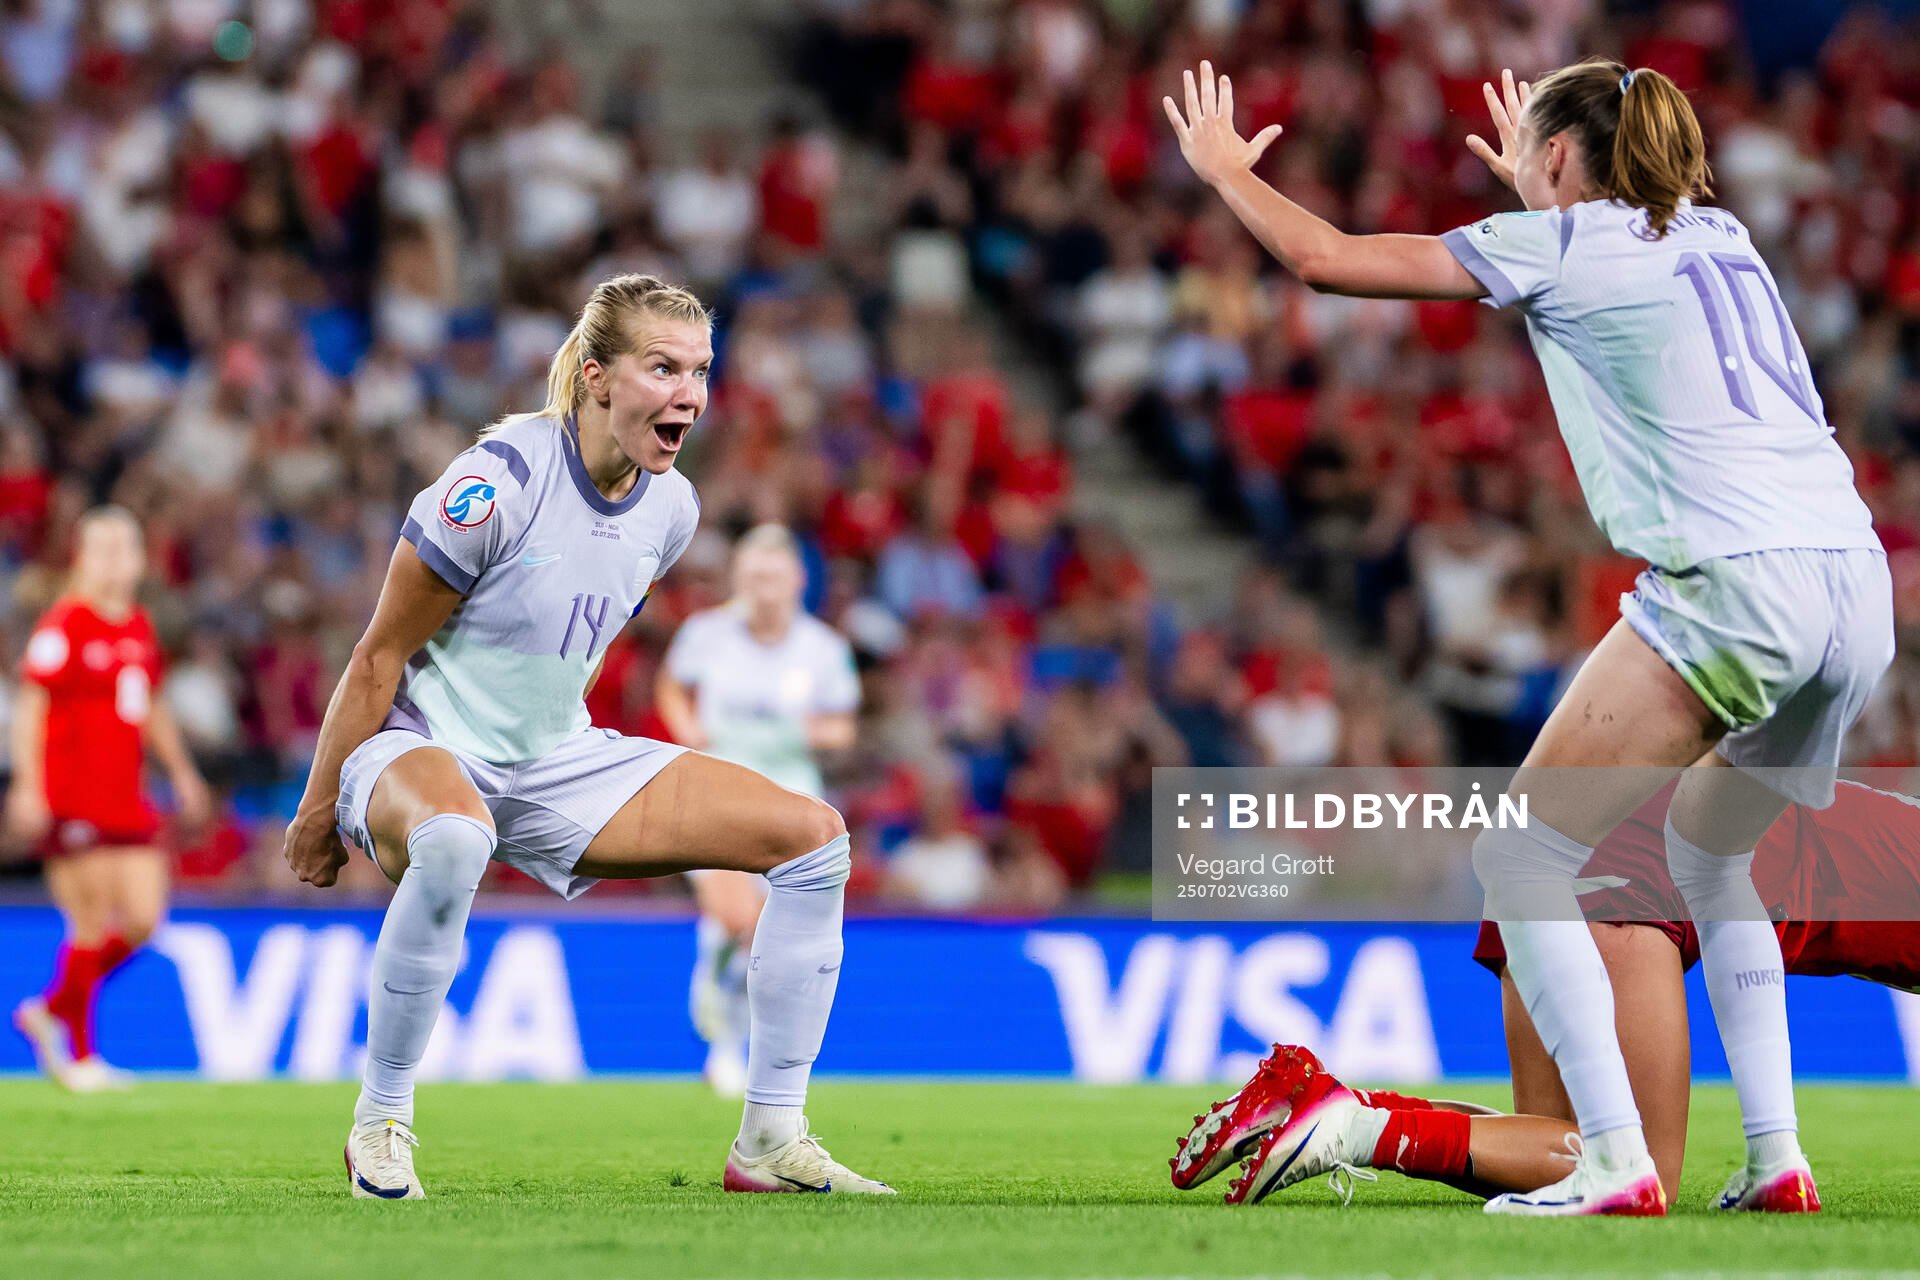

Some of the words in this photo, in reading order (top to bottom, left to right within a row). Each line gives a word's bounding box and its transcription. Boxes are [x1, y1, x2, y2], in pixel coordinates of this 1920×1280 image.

[1673, 252, 1823, 427] 10
[559, 593, 611, 662] 14
[155, 922, 590, 1082] VIA
[1023, 931, 1443, 1083] VISA
[1735, 968, 1783, 991] NORG
